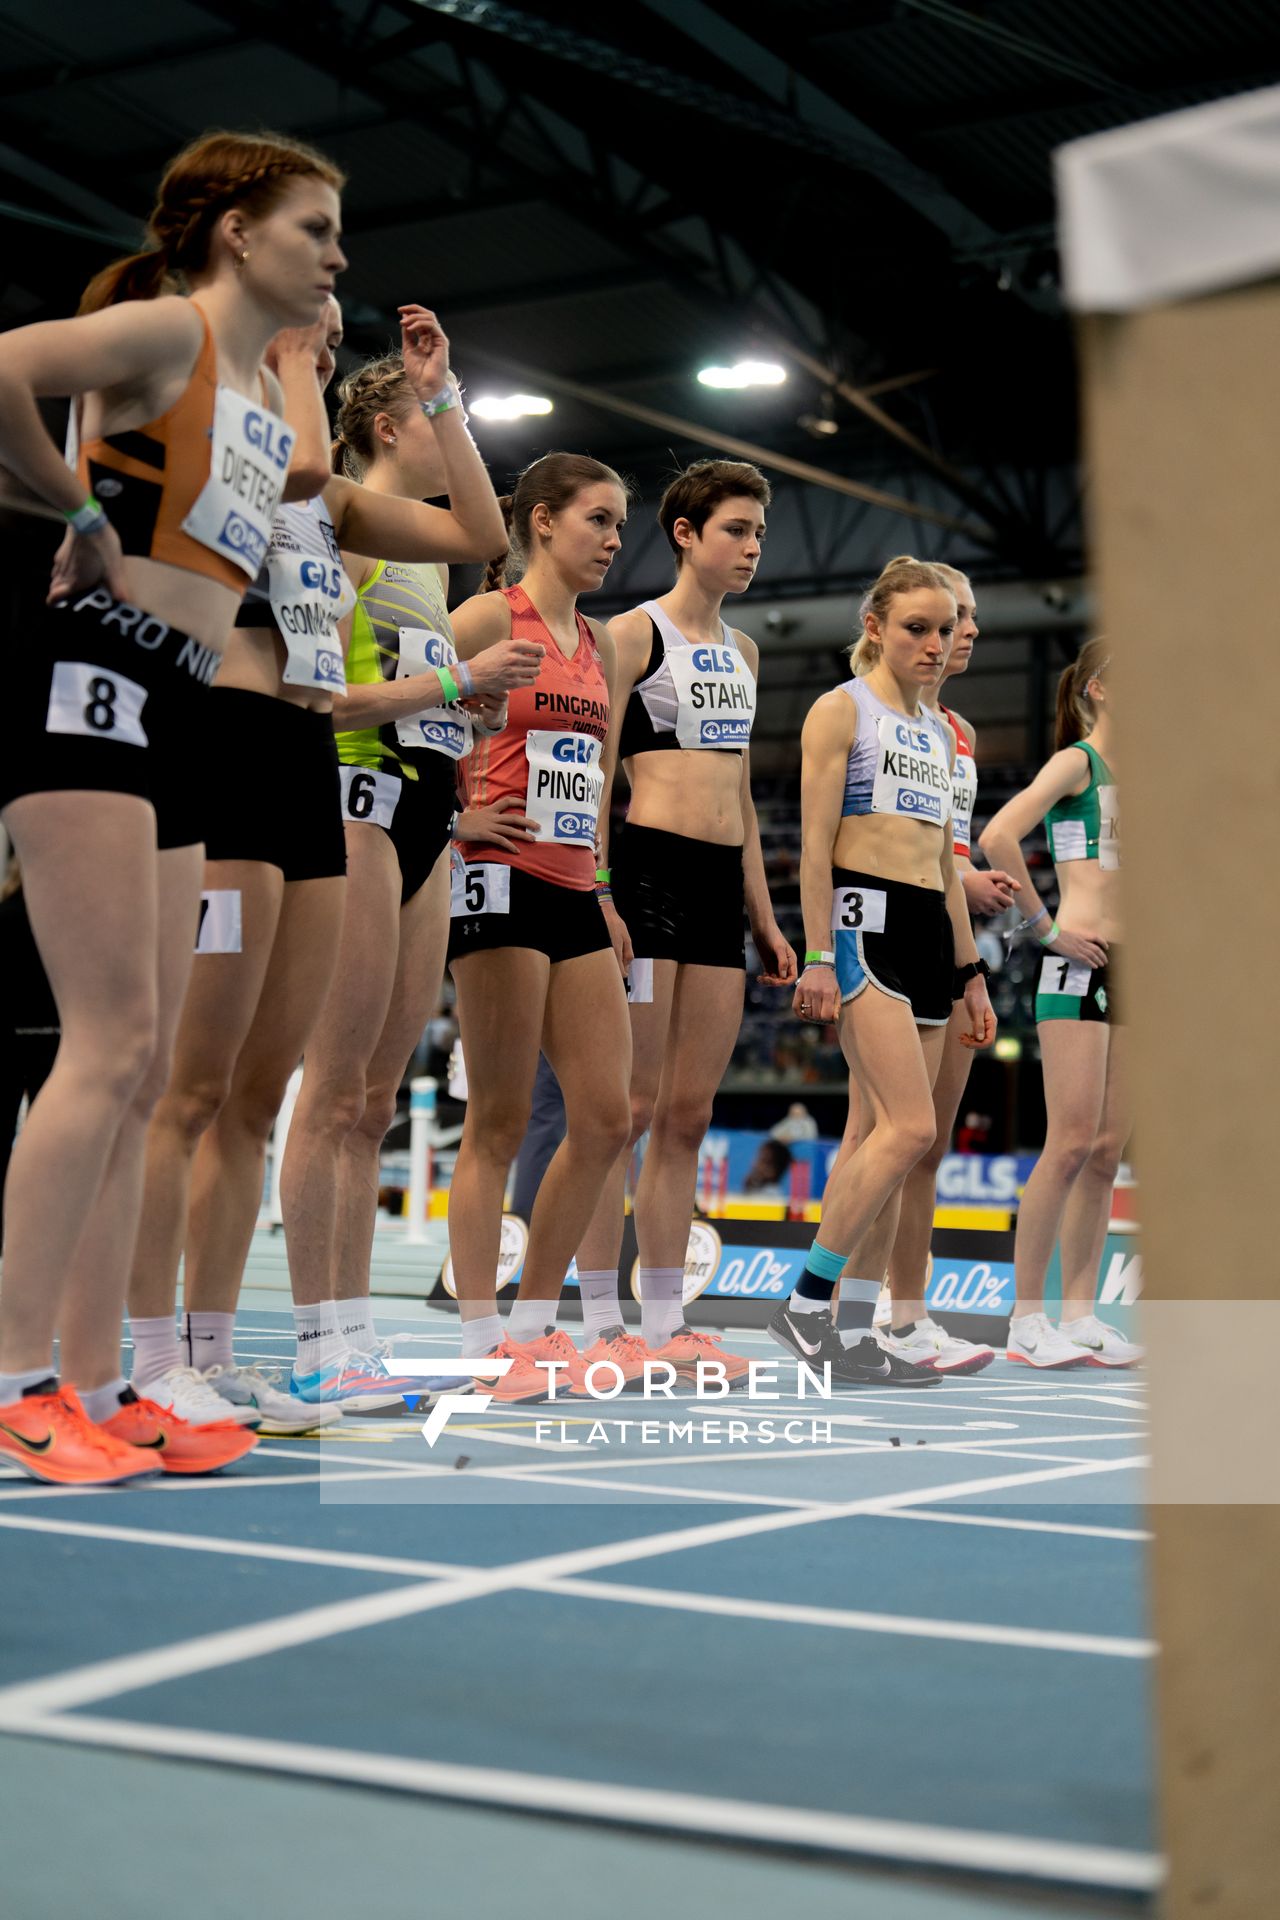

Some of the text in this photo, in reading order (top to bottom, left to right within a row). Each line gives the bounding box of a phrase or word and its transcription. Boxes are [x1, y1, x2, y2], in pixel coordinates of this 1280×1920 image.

[243, 411, 293, 470] GLS
[73, 585, 170, 650] PRO
[84, 677, 117, 731] 8
[690, 681, 753, 711] STAHL
[722, 723, 750, 735] PLAN
[883, 749, 950, 793] KERRES
[347, 773, 377, 819] 6
[917, 795, 940, 811] PLAN
[465, 870, 486, 912] 5
[841, 892, 864, 928] 3
[1056, 962, 1070, 991] 1
[717, 1249, 793, 1295] 0,0%
[930, 1263, 1010, 1310] 0,0%
